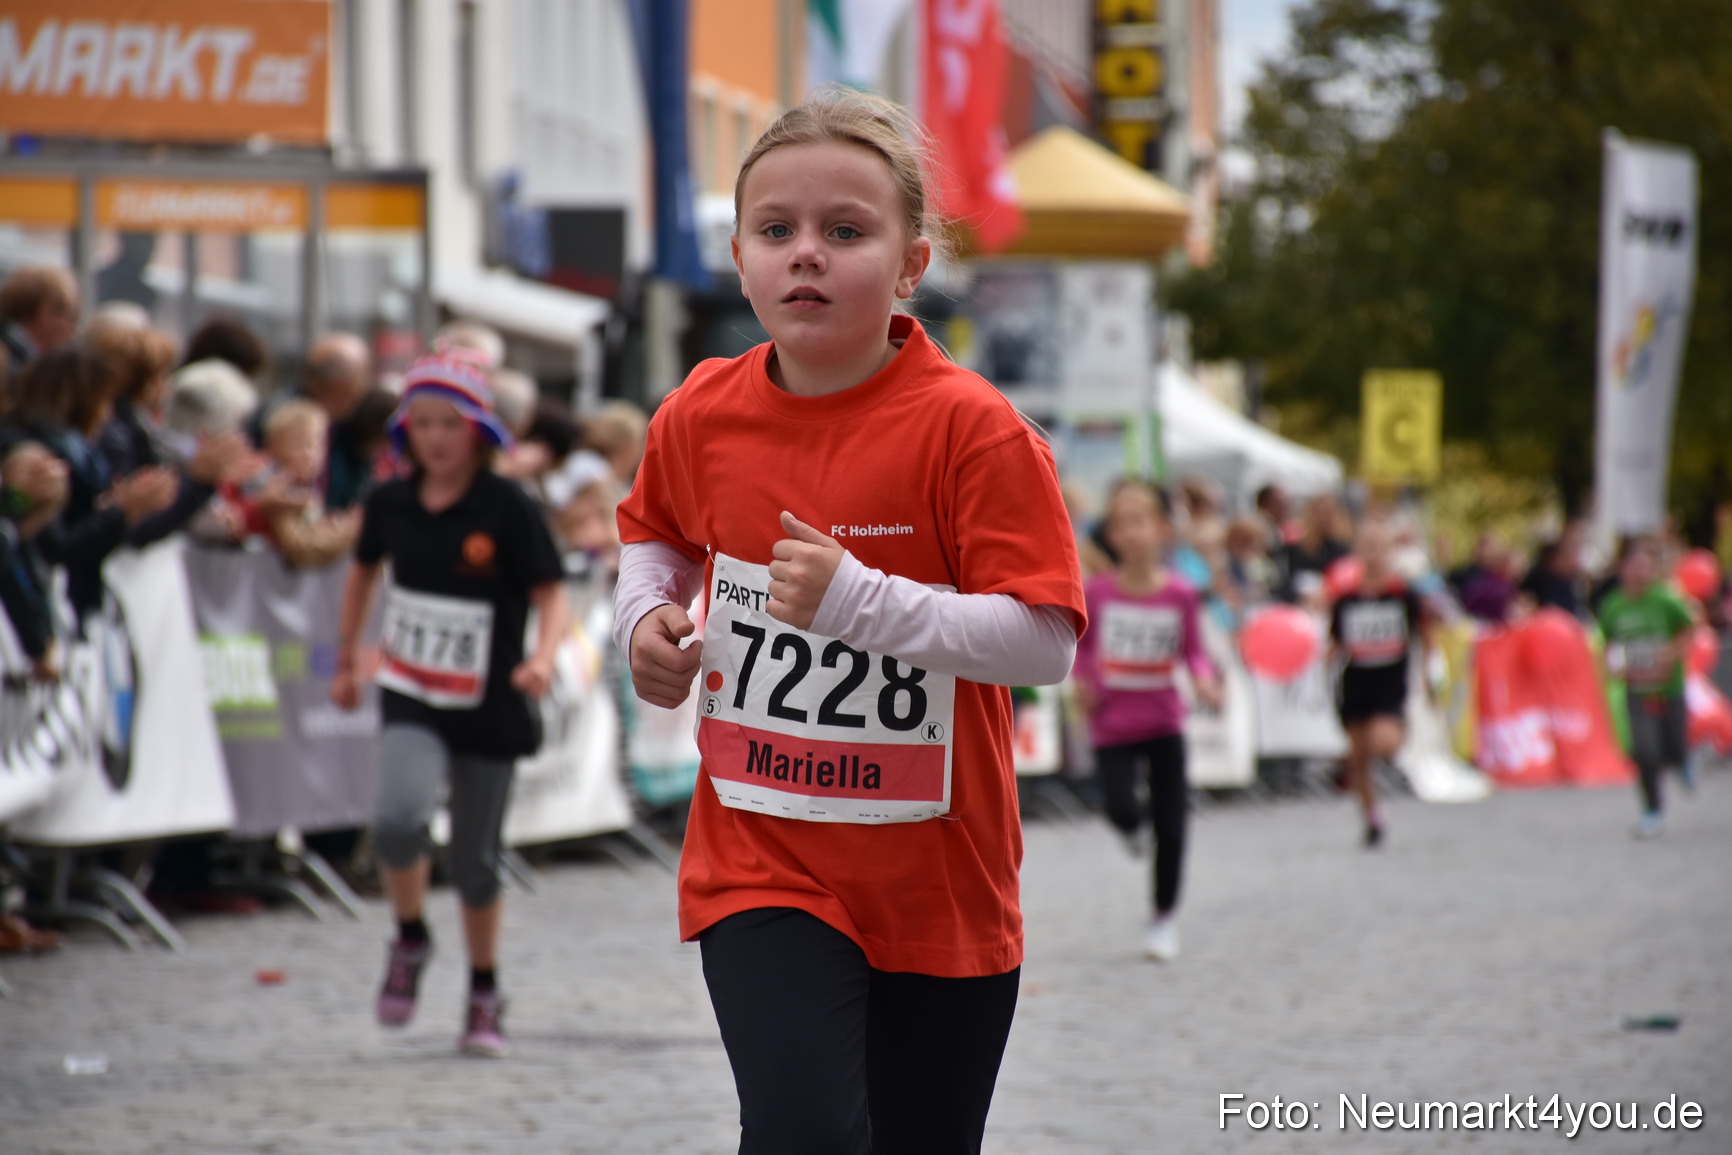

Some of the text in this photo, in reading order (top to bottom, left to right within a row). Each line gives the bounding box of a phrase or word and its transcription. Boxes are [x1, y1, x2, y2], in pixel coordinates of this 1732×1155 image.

[831, 523, 913, 537] FC Holzheim
[731, 620, 927, 731] 7228
[706, 698, 716, 715] 5
[927, 724, 938, 740] K
[746, 740, 881, 790] Mariella
